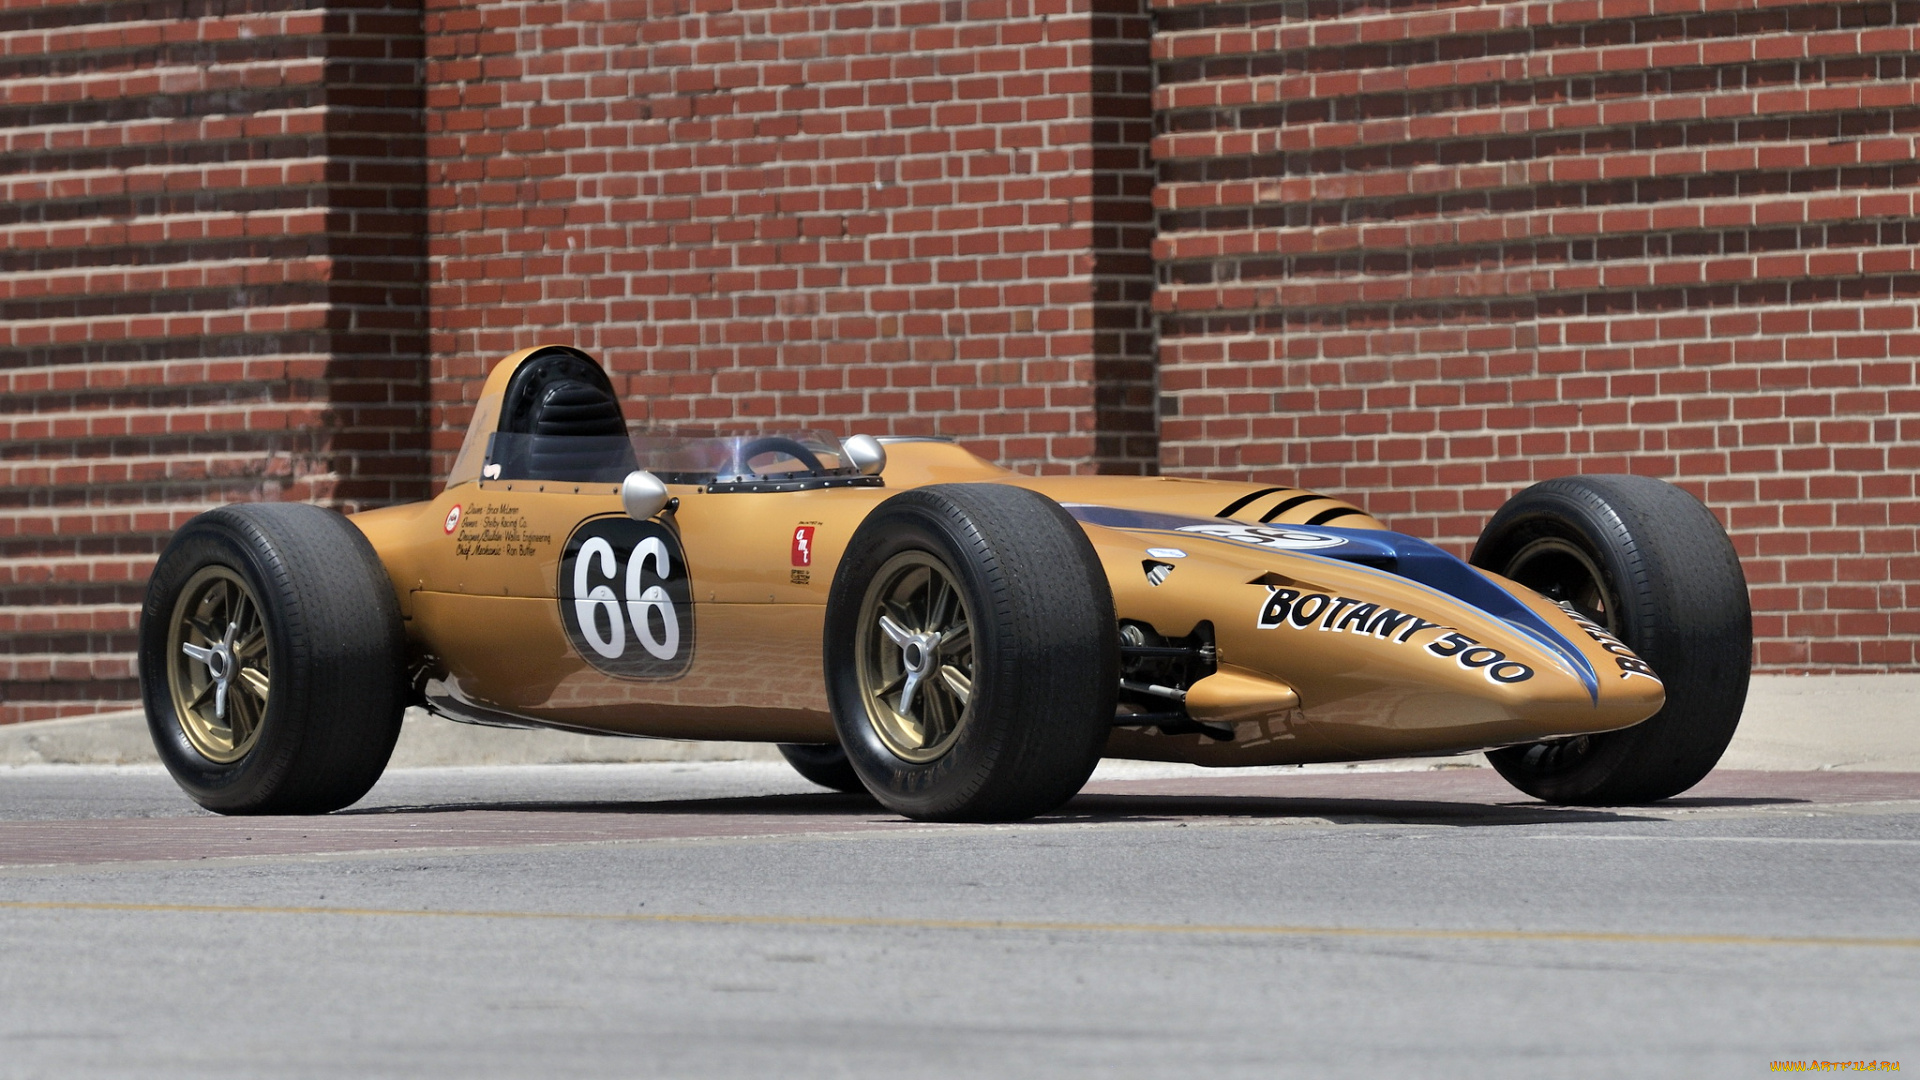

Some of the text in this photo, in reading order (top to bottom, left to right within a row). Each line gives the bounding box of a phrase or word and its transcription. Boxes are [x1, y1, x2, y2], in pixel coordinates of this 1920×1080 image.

[574, 536, 680, 661] 66
[1257, 585, 1536, 685] BOTANY 500
